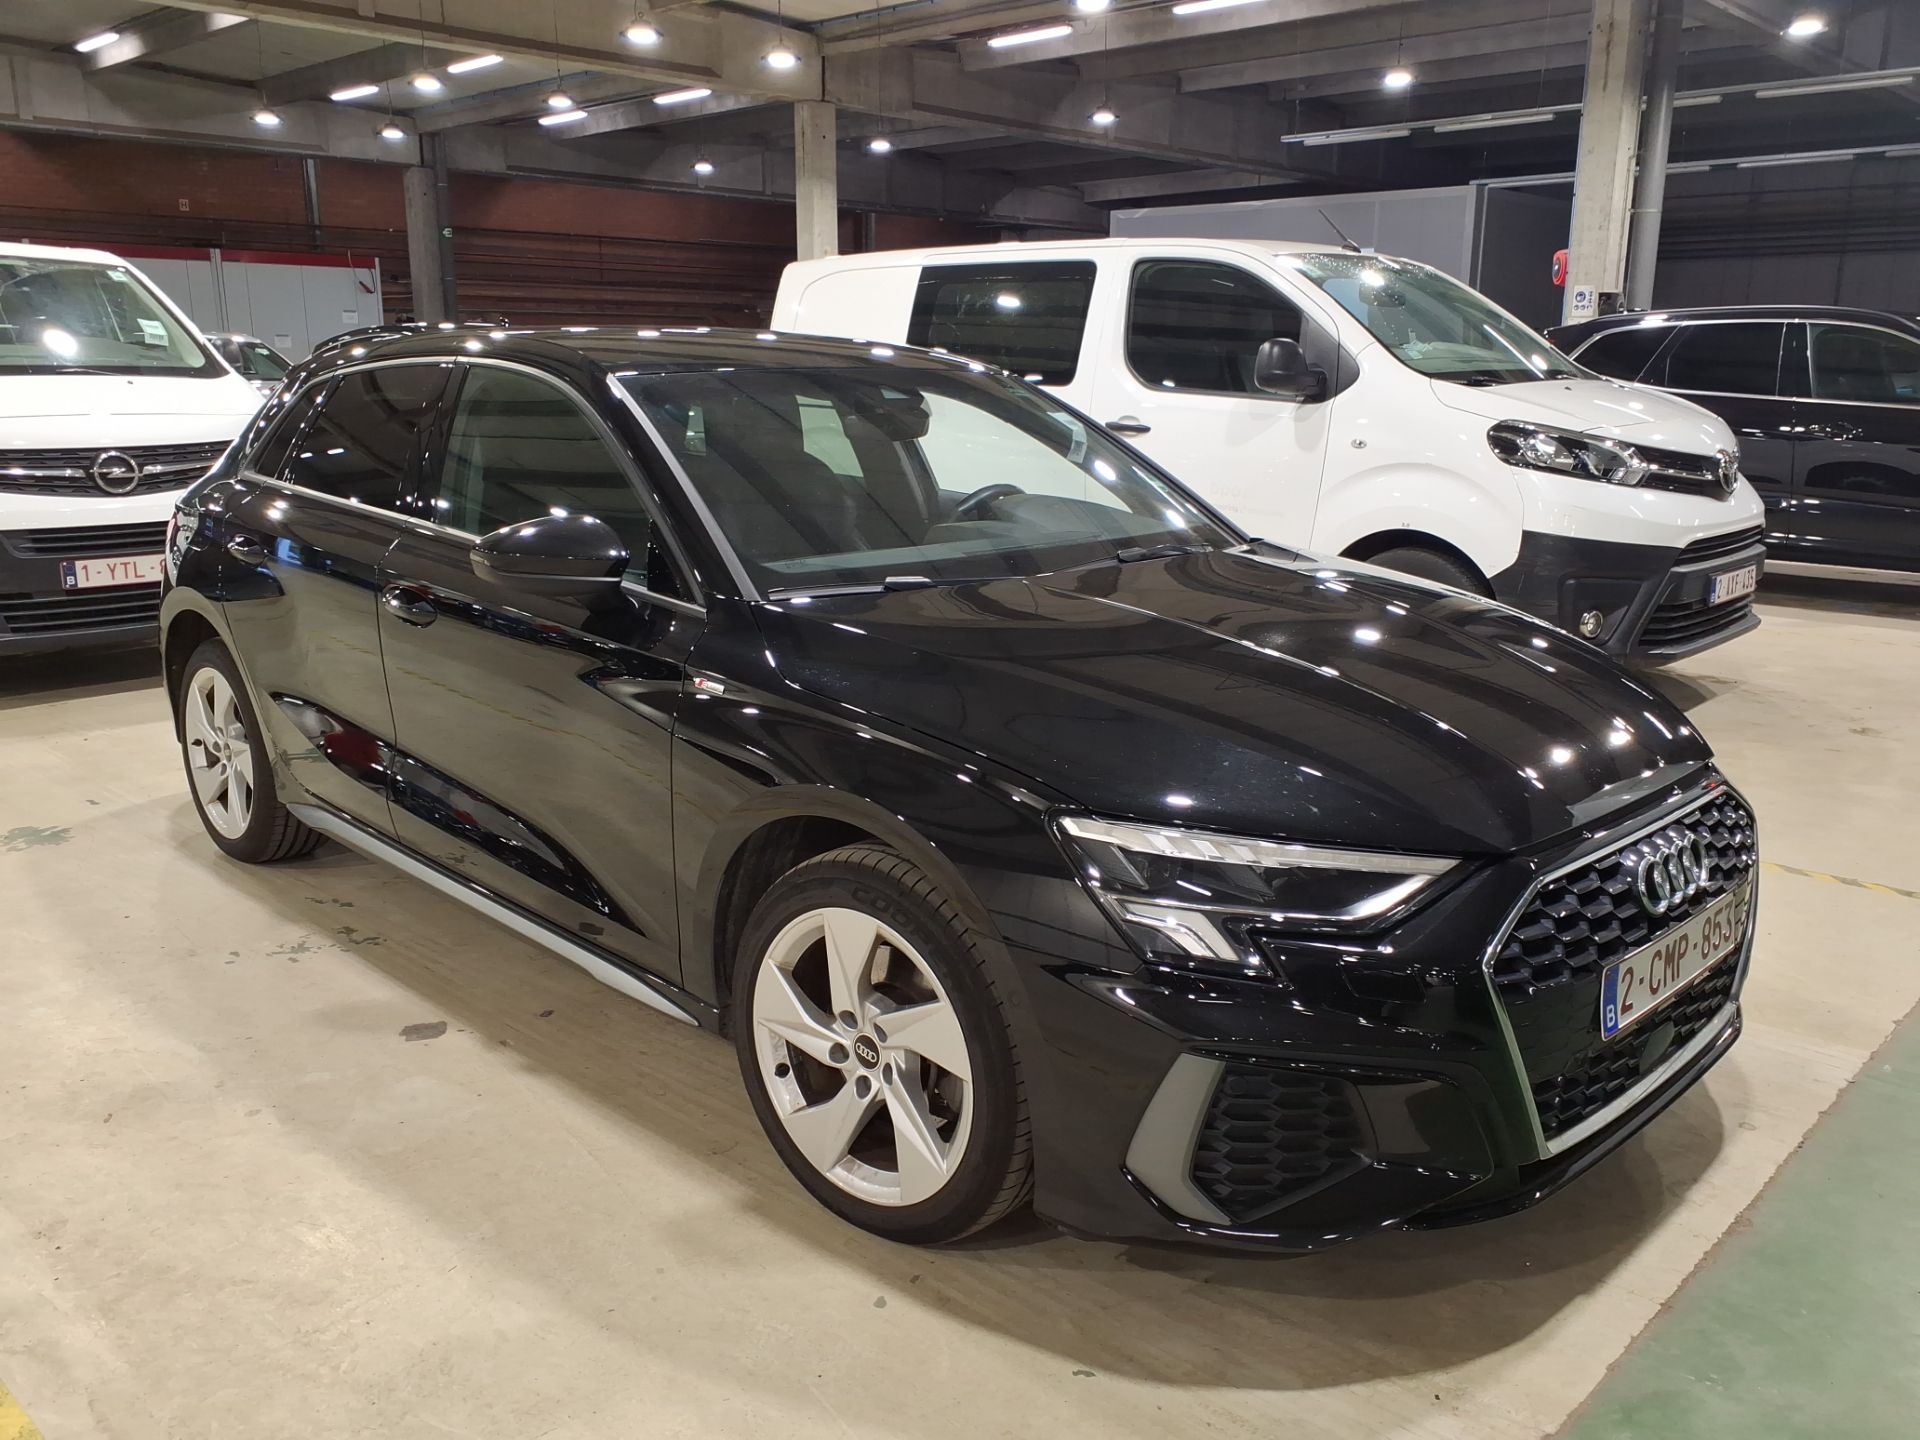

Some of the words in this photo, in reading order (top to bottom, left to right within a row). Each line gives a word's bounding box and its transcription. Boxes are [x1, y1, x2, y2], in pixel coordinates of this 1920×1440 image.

[66, 576, 76, 585] B
[1620, 902, 1733, 1016] 2-CMP-853
[1606, 1004, 1616, 1028] B
